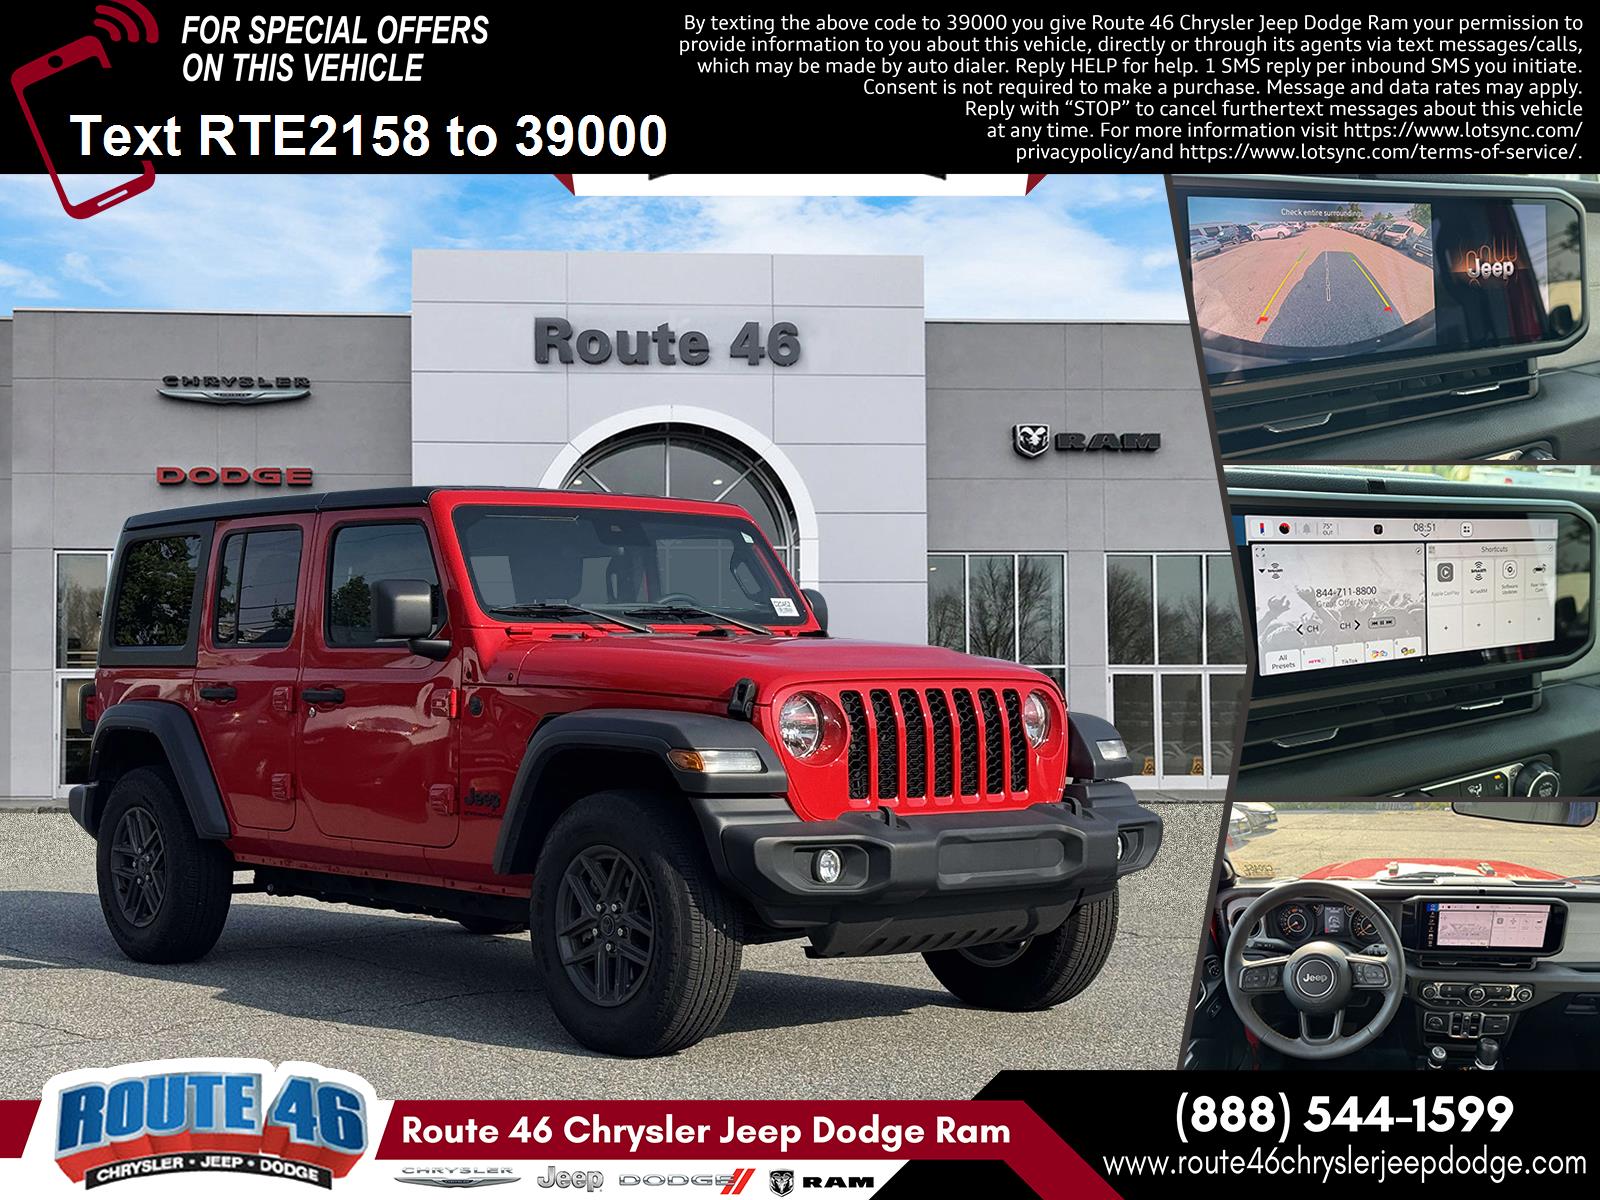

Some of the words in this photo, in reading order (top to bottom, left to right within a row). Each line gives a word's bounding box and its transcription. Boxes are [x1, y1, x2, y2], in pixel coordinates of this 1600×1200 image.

[1281, 207, 1302, 217] Check
[1303, 209, 1323, 217] entire
[1466, 258, 1514, 281] Jeep
[534, 317, 710, 366] Route
[729, 321, 801, 367] 46
[162, 375, 311, 389] CHRYSLER
[1054, 432, 1161, 453] RAM
[156, 466, 313, 486] DODGE
[1413, 522, 1437, 533] 08:51
[1315, 585, 1377, 598] 844-711-8800
[1307, 624, 1319, 633] CH
[1340, 622, 1351, 630] CH
[1271, 662, 1296, 671] Presets
[463, 787, 501, 809] Jeep
[1303, 973, 1328, 983] Jeep
